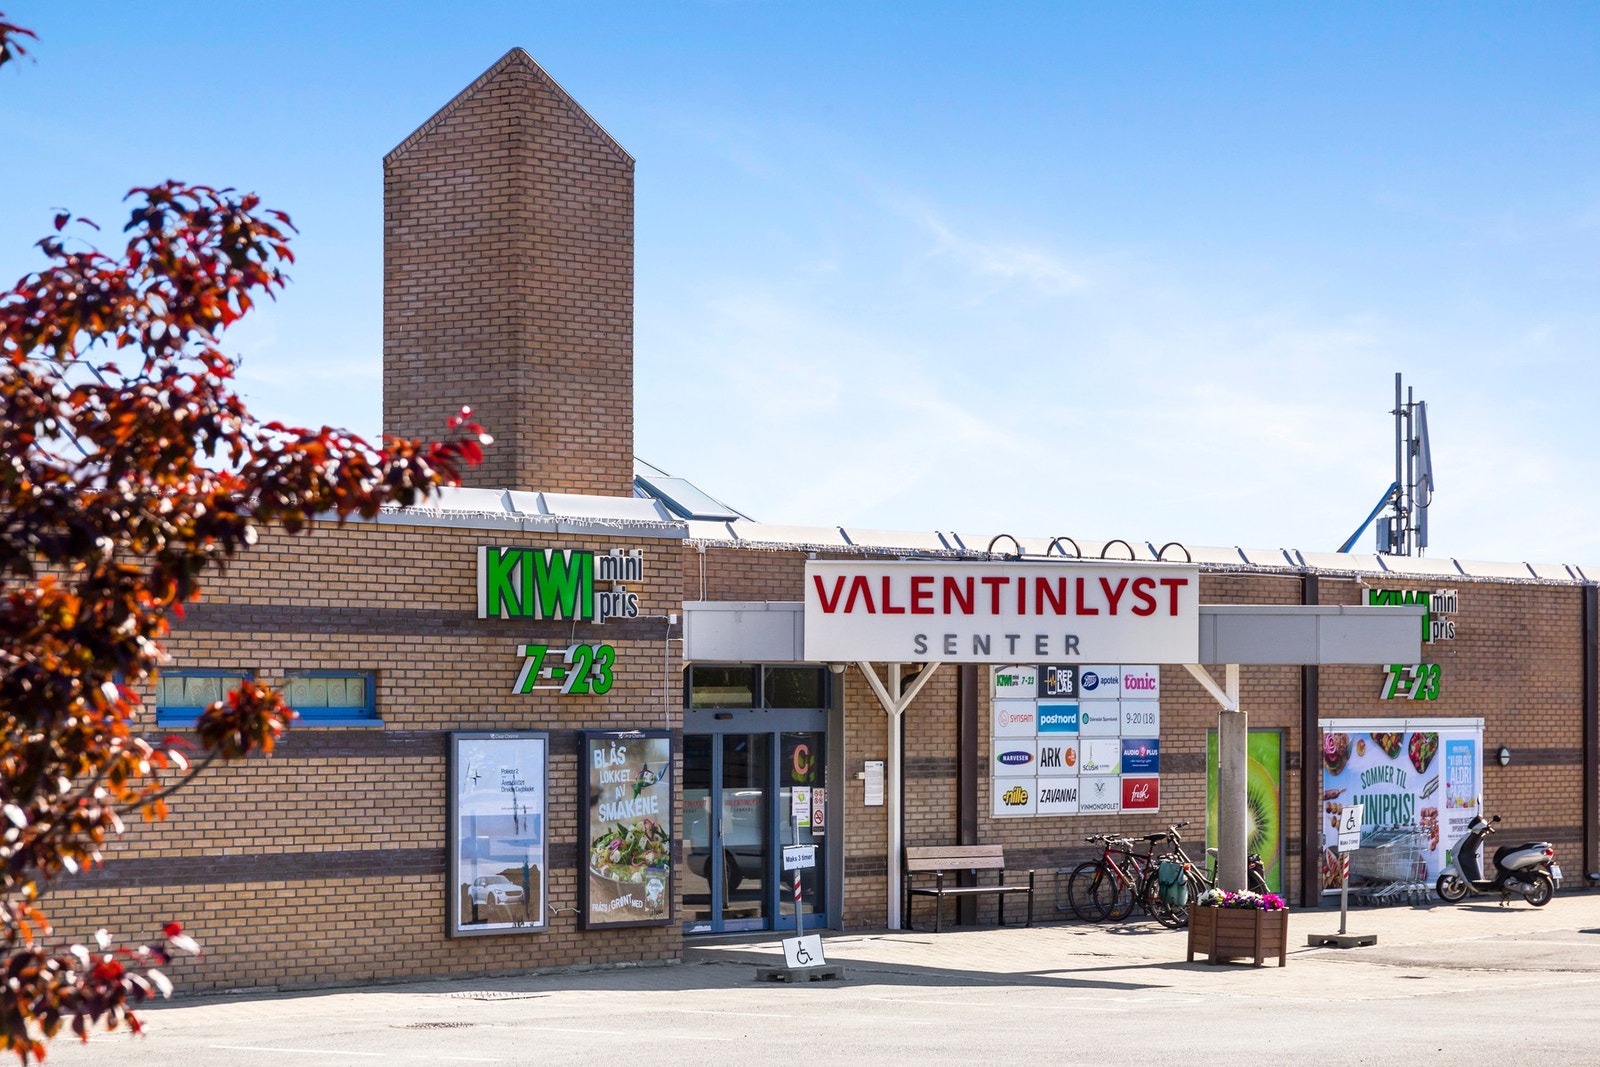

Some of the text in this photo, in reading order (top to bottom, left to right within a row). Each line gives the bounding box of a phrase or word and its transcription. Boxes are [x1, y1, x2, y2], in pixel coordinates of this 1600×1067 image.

[599, 548, 643, 580] mini
[484, 546, 595, 621] KIWI
[812, 575, 1189, 617] VALENTINLYST
[1432, 589, 1458, 613] mini
[599, 585, 639, 624] pris
[1432, 616, 1456, 644] pris
[913, 633, 1081, 656] SENTER
[517, 643, 616, 694] 7-23
[1057, 669, 1073, 682] REP
[996, 674, 1012, 687] KIWI
[1021, 676, 1035, 685] 7-23
[1057, 681, 1073, 693] LAB
[1100, 676, 1119, 686] apotek
[1124, 672, 1156, 690] tonic
[1384, 663, 1442, 701] 7-23
[1040, 713, 1077, 726] postnord
[1126, 712, 1155, 725] 9-20 (18)
[593, 741, 627, 769] BLÅS
[1002, 754, 1029, 762] NARVESEN
[1040, 747, 1062, 768] ARK
[1146, 748, 1159, 756] PLUS
[600, 769, 630, 784] LOKKET
[1360, 765, 1407, 790] SOMMER TIL
[615, 785, 626, 800] AV
[1040, 788, 1077, 803] ZAVANNA
[598, 795, 659, 823] SMAKENE
[1080, 803, 1119, 811] VINMONOPOLET
[786, 855, 798, 863] Maks
[801, 853, 813, 861] timer
[631, 899, 643, 909] MED
